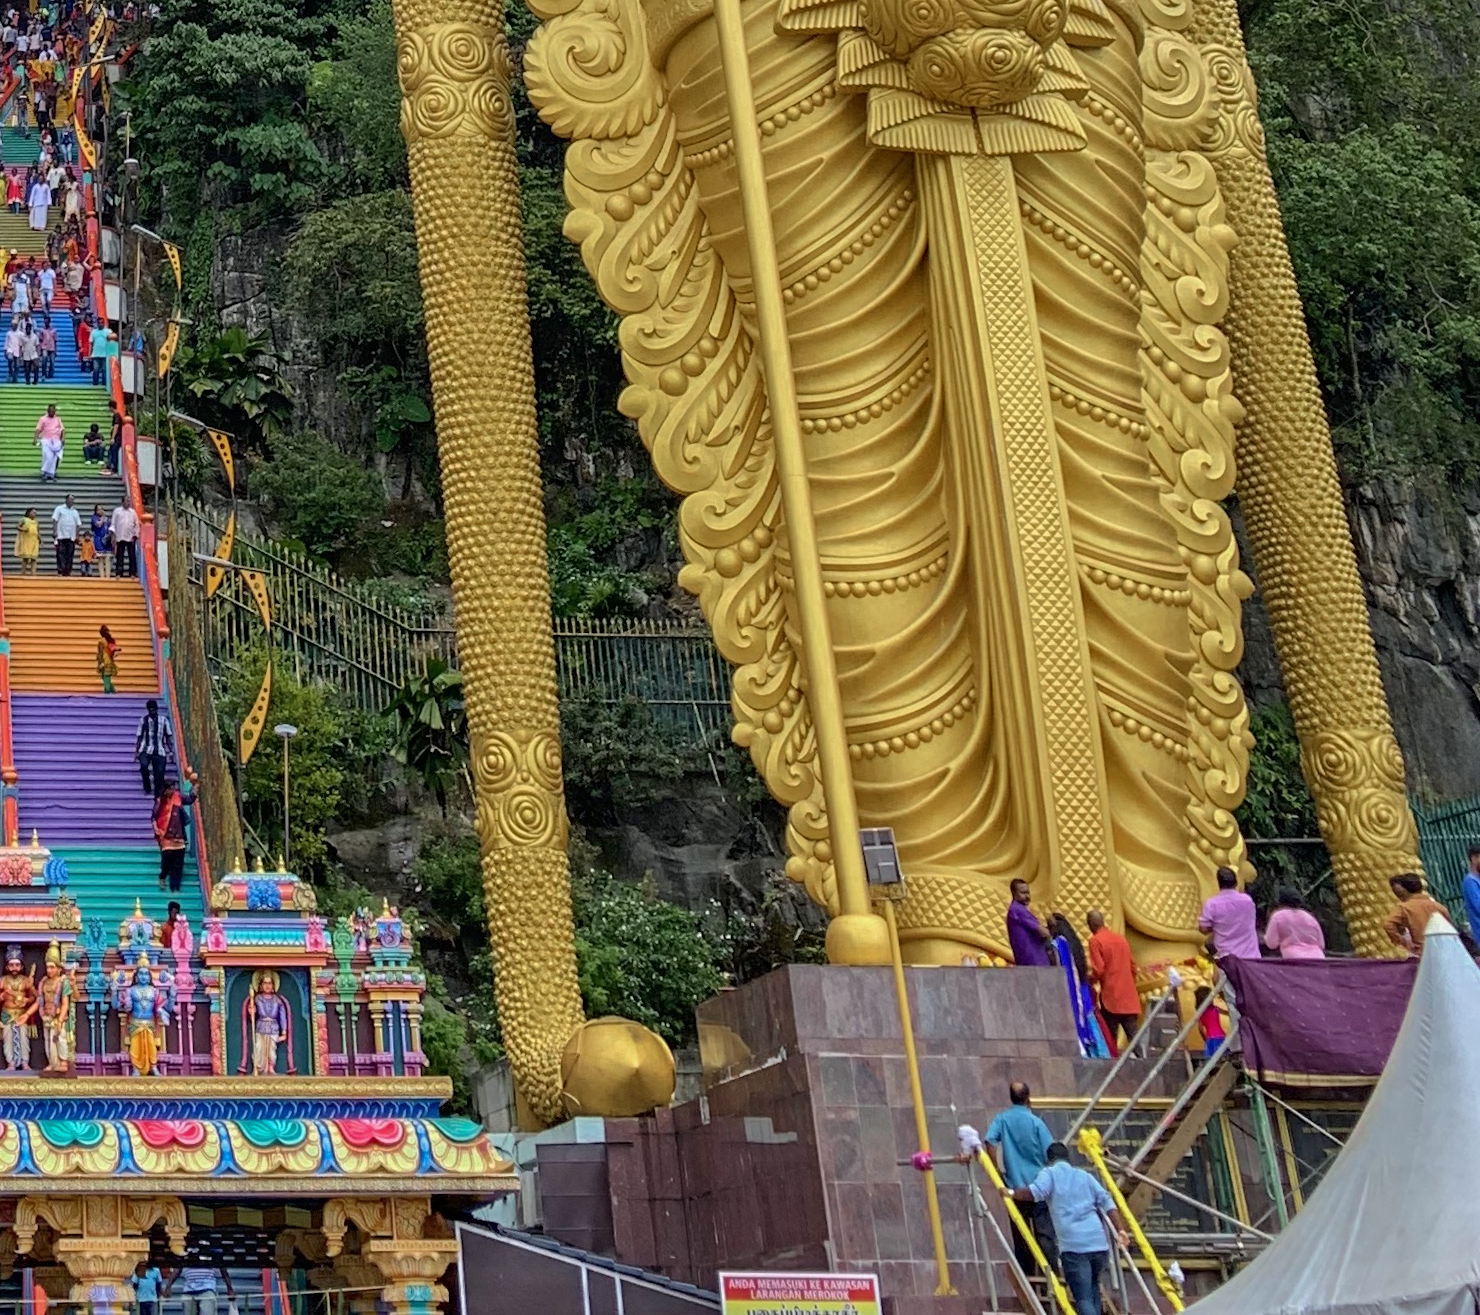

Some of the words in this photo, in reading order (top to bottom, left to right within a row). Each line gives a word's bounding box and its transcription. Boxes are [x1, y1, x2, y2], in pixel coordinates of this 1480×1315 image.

[728, 1279, 755, 1289] ANDA
[757, 1279, 807, 1289] MEMASUKI
[810, 1280, 821, 1290] KE
[823, 1280, 870, 1290] KAWASAN
[750, 1290, 801, 1300] LARANGAN
[804, 1291, 850, 1300] MEROKOK
